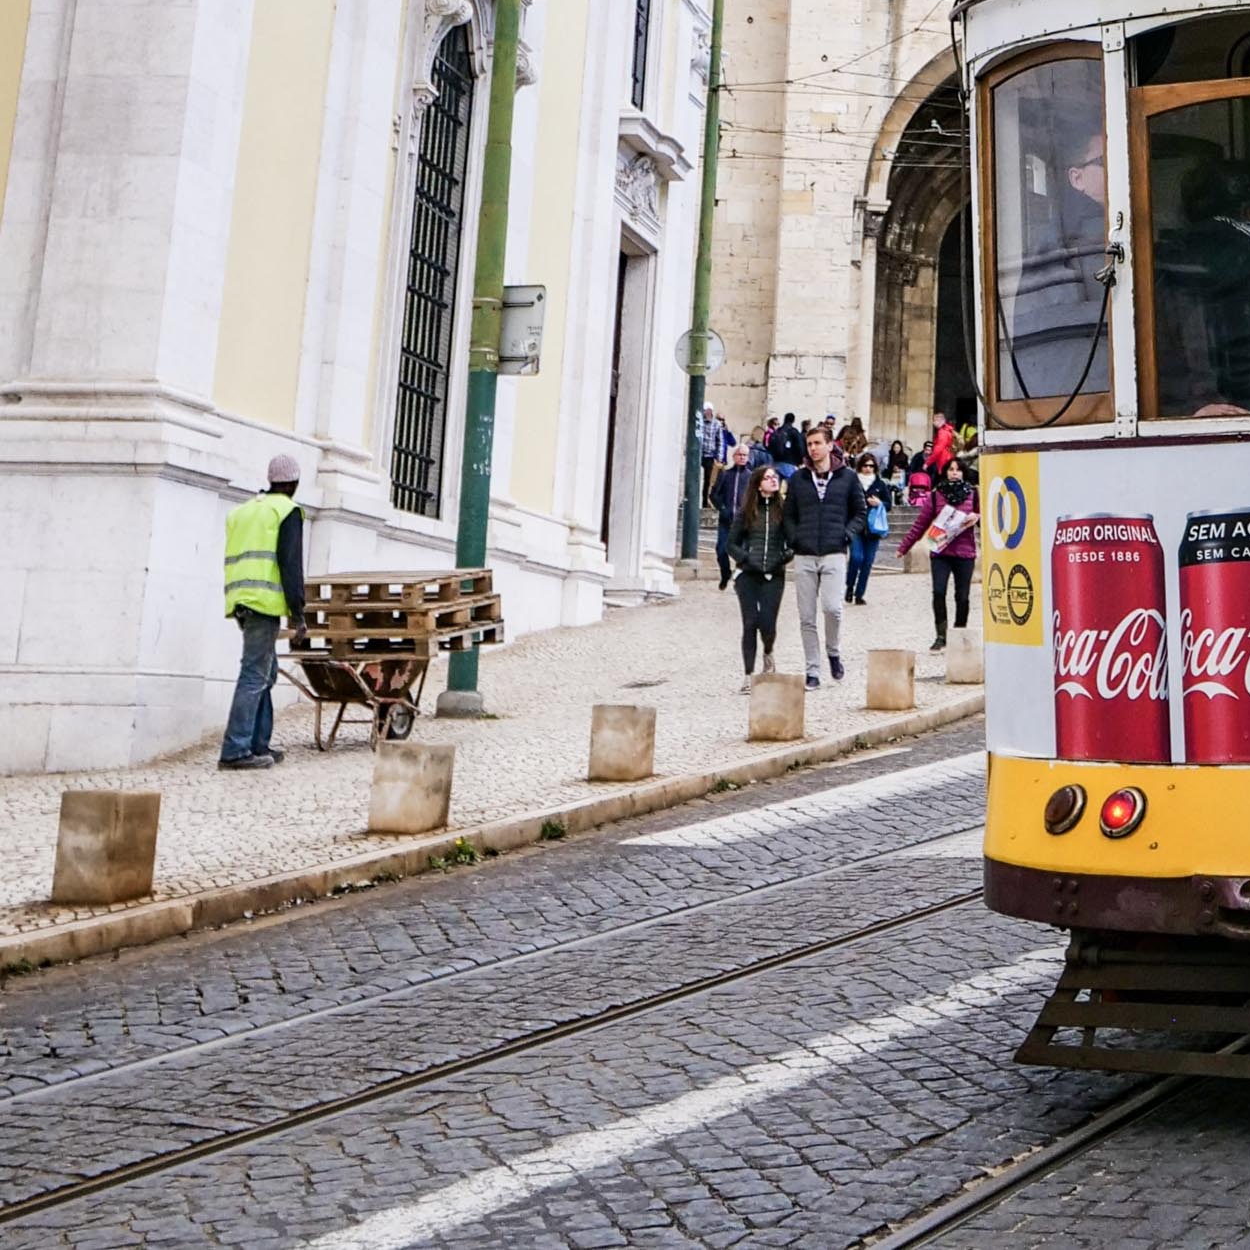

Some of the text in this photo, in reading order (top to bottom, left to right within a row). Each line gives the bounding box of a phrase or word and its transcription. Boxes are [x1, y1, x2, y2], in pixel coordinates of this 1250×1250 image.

[1055, 523, 1158, 546] SABOR ORIGINAL
[1187, 522, 1226, 542] SEM
[1068, 550, 1140, 563] DESDE 1886
[1196, 548, 1226, 561] SEM
